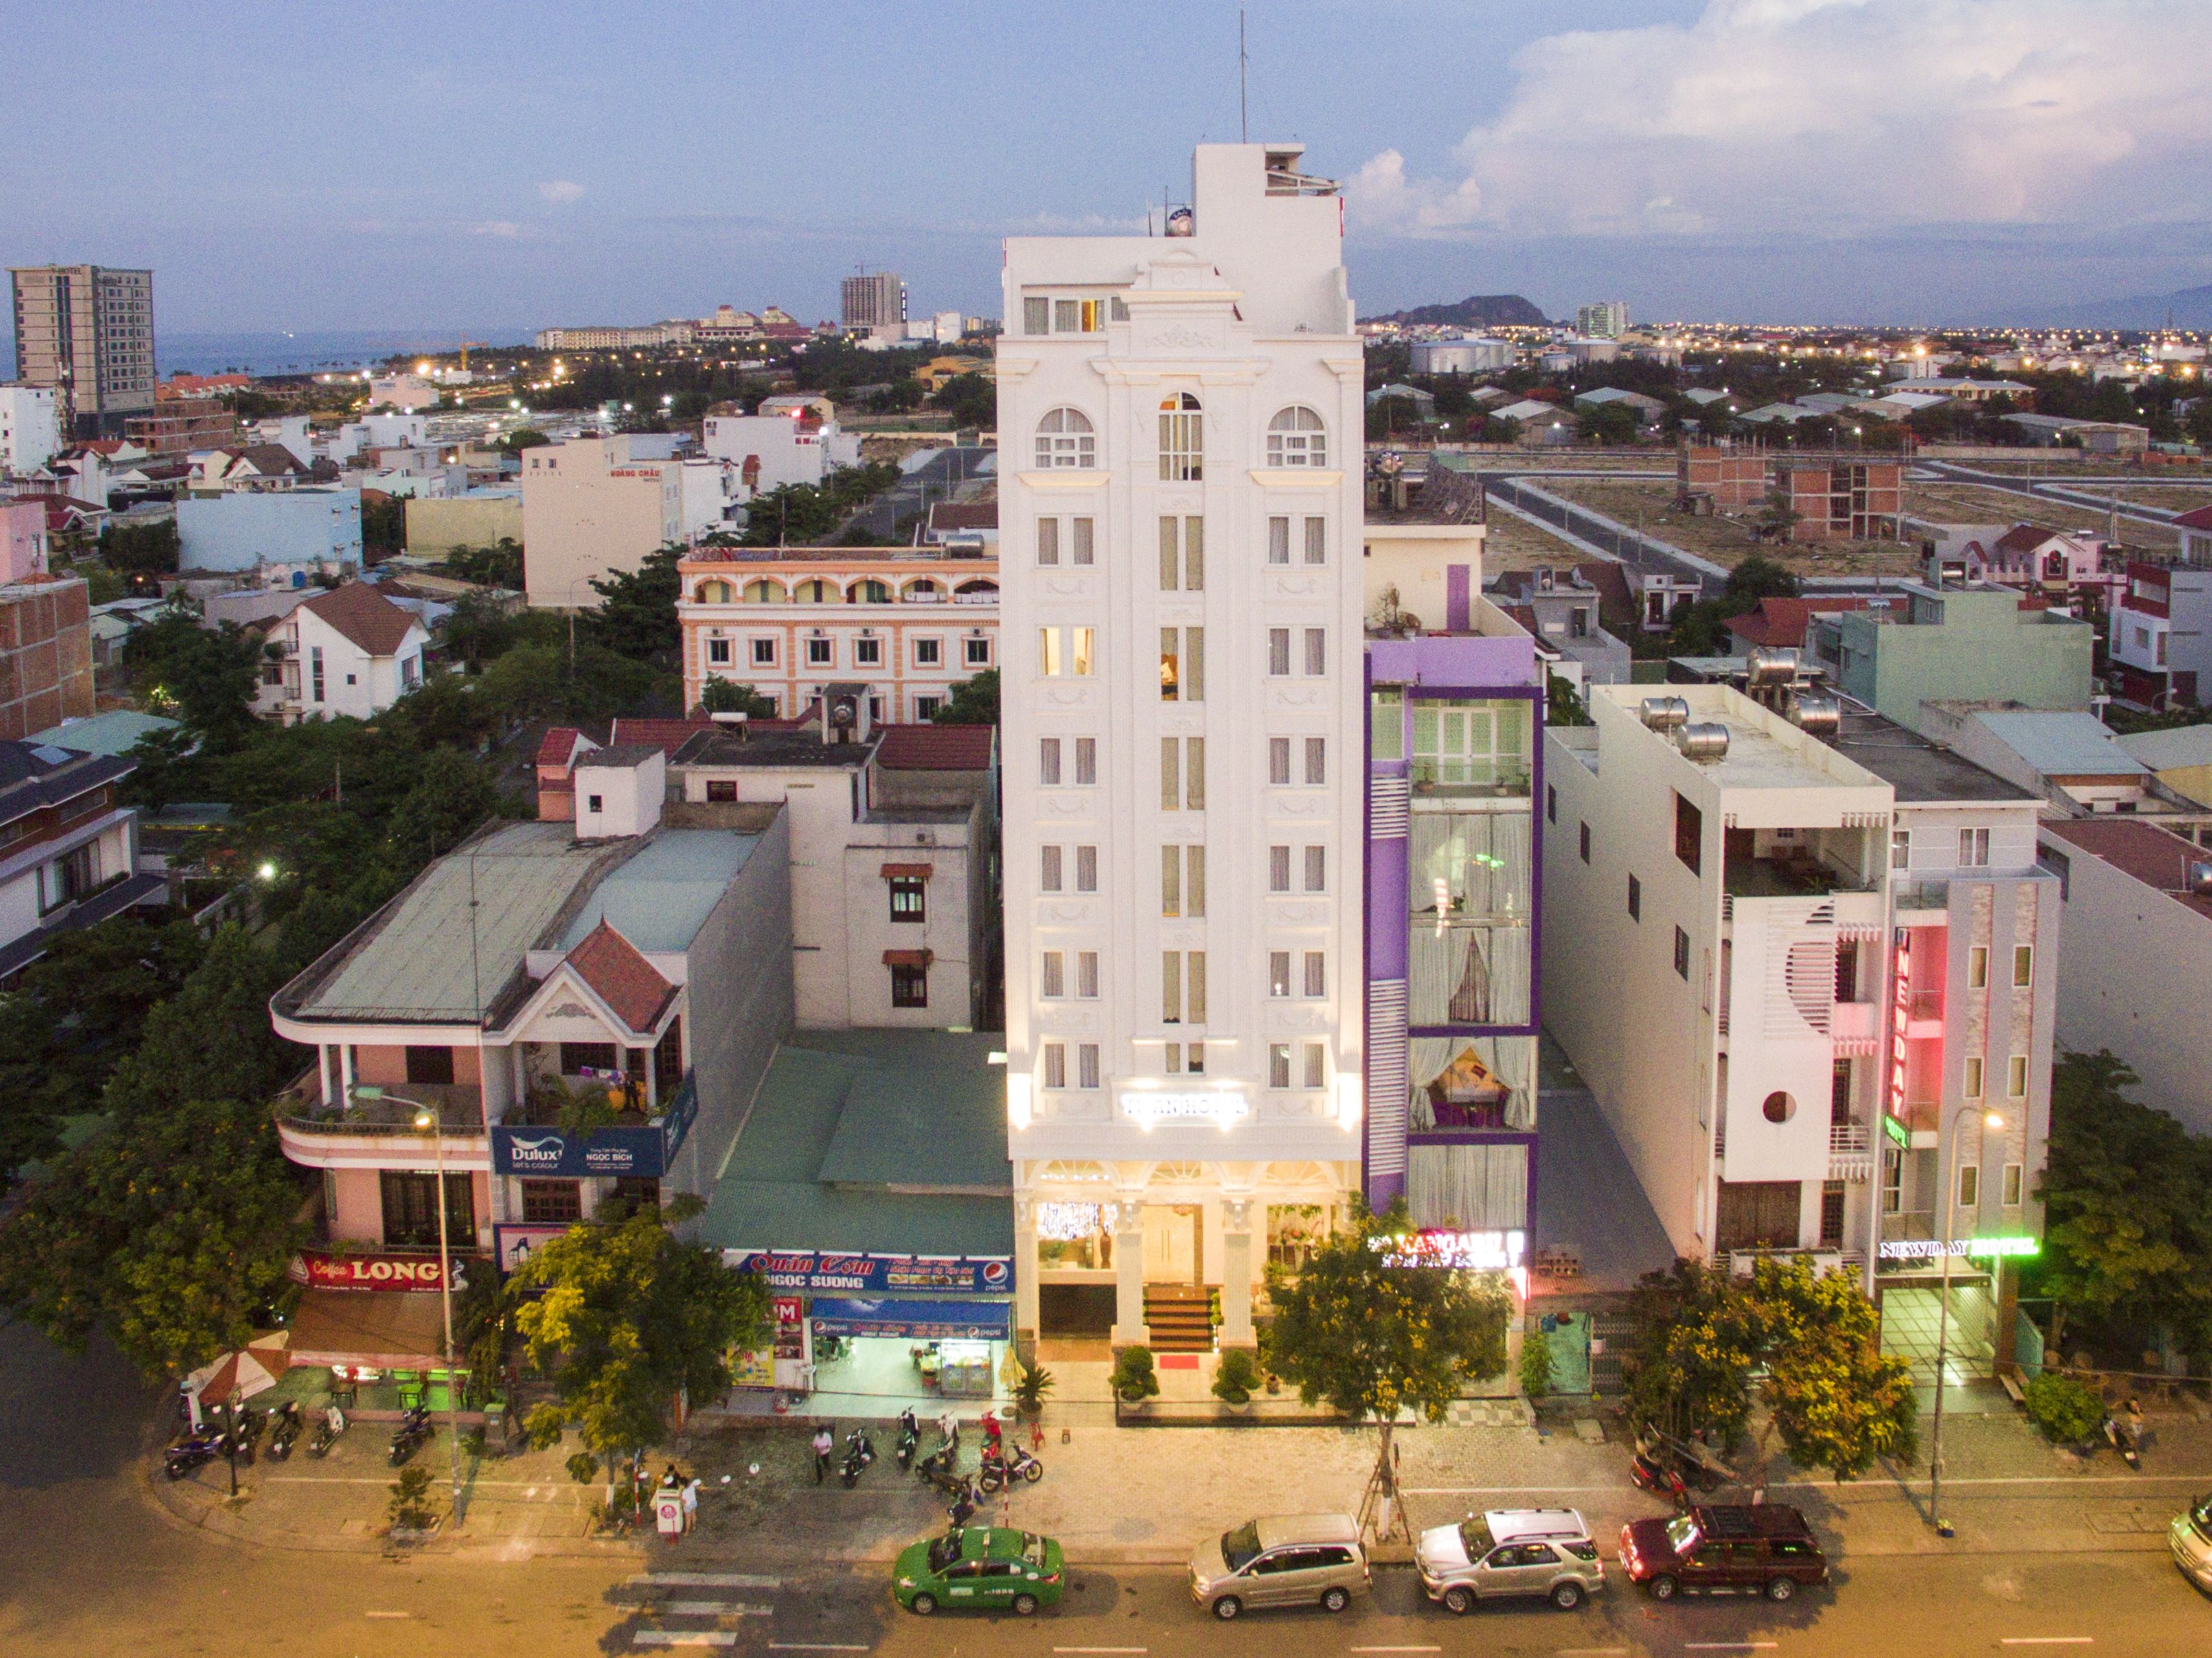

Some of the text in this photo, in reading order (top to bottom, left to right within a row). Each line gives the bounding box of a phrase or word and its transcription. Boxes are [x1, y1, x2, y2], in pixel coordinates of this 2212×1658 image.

[1891, 949, 1909, 1118] NEWDAY
[1185, 1099, 1245, 1114] HOL
[512, 1147, 558, 1160] Dulux
[1880, 1240, 1970, 1258] NEWDAY
[313, 1260, 347, 1278] Coffee
[351, 1261, 441, 1281] LONG
[980, 1328, 1001, 1337] pepsi
